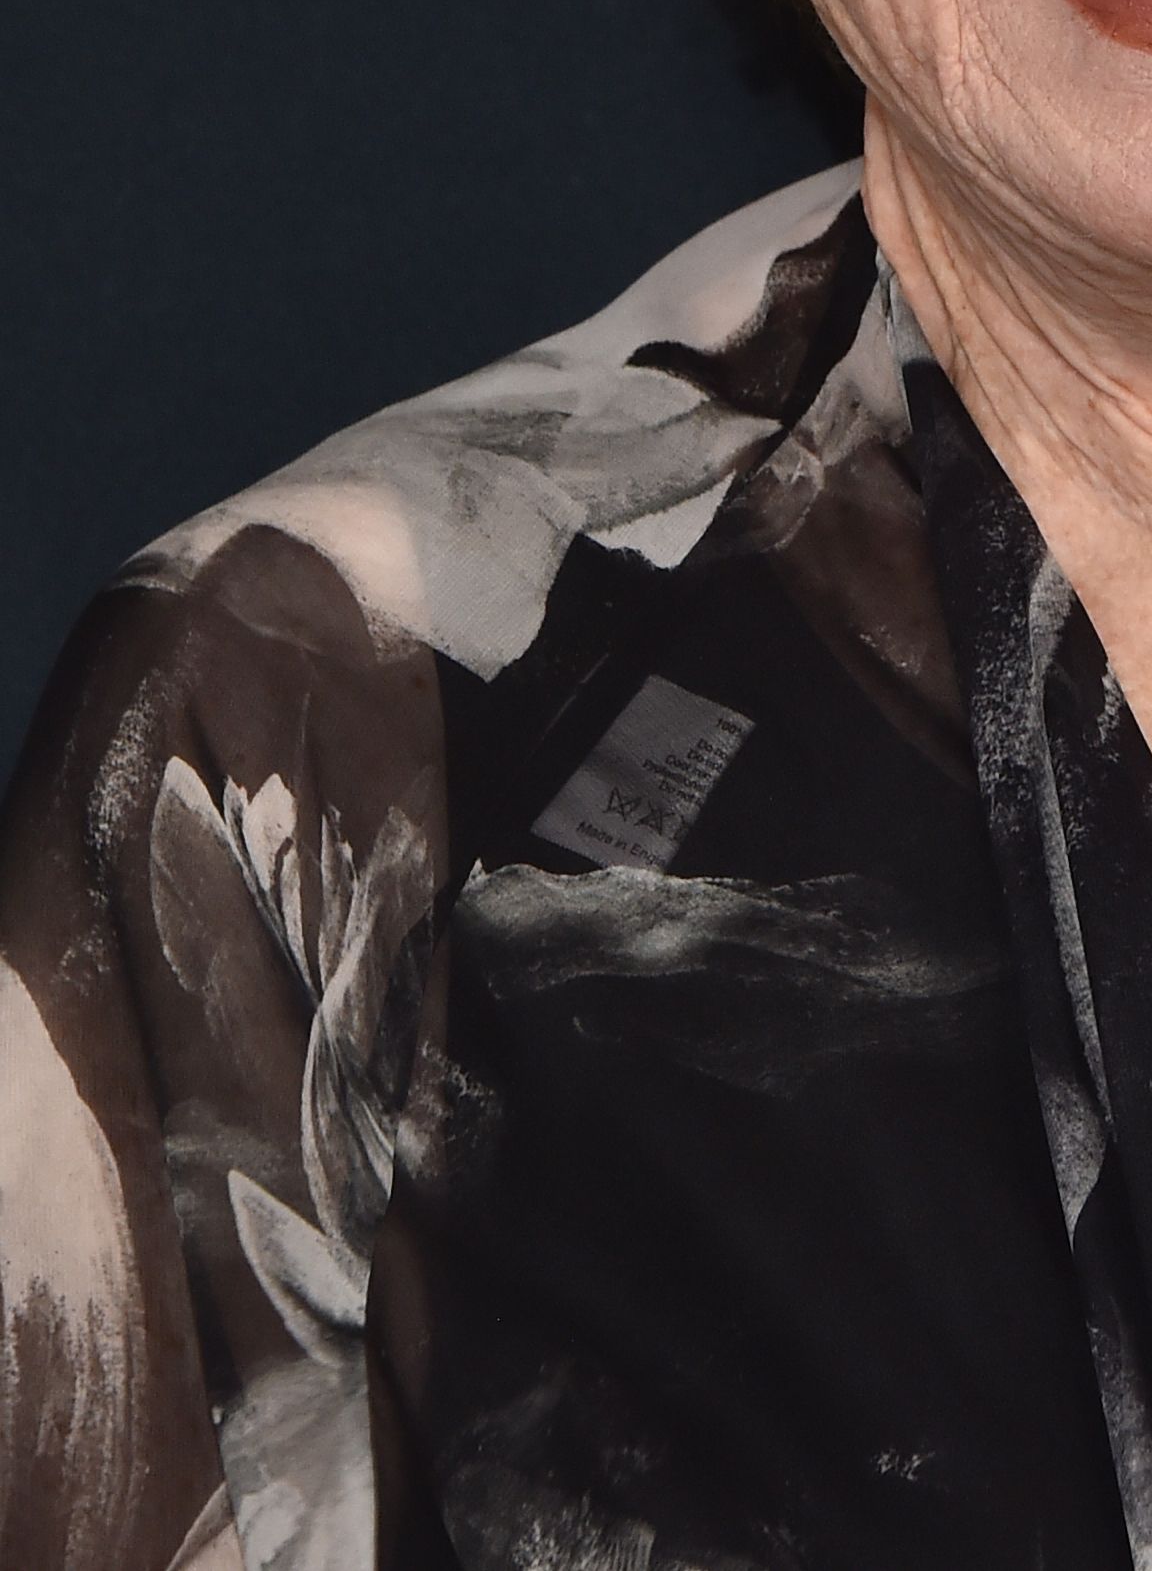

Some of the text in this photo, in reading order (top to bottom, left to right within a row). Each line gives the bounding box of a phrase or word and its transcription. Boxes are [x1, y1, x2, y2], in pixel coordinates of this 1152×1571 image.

[697, 738, 714, 752] Do
[687, 748, 705, 762] Do
[577, 820, 614, 843] Made
[615, 836, 628, 850] in
